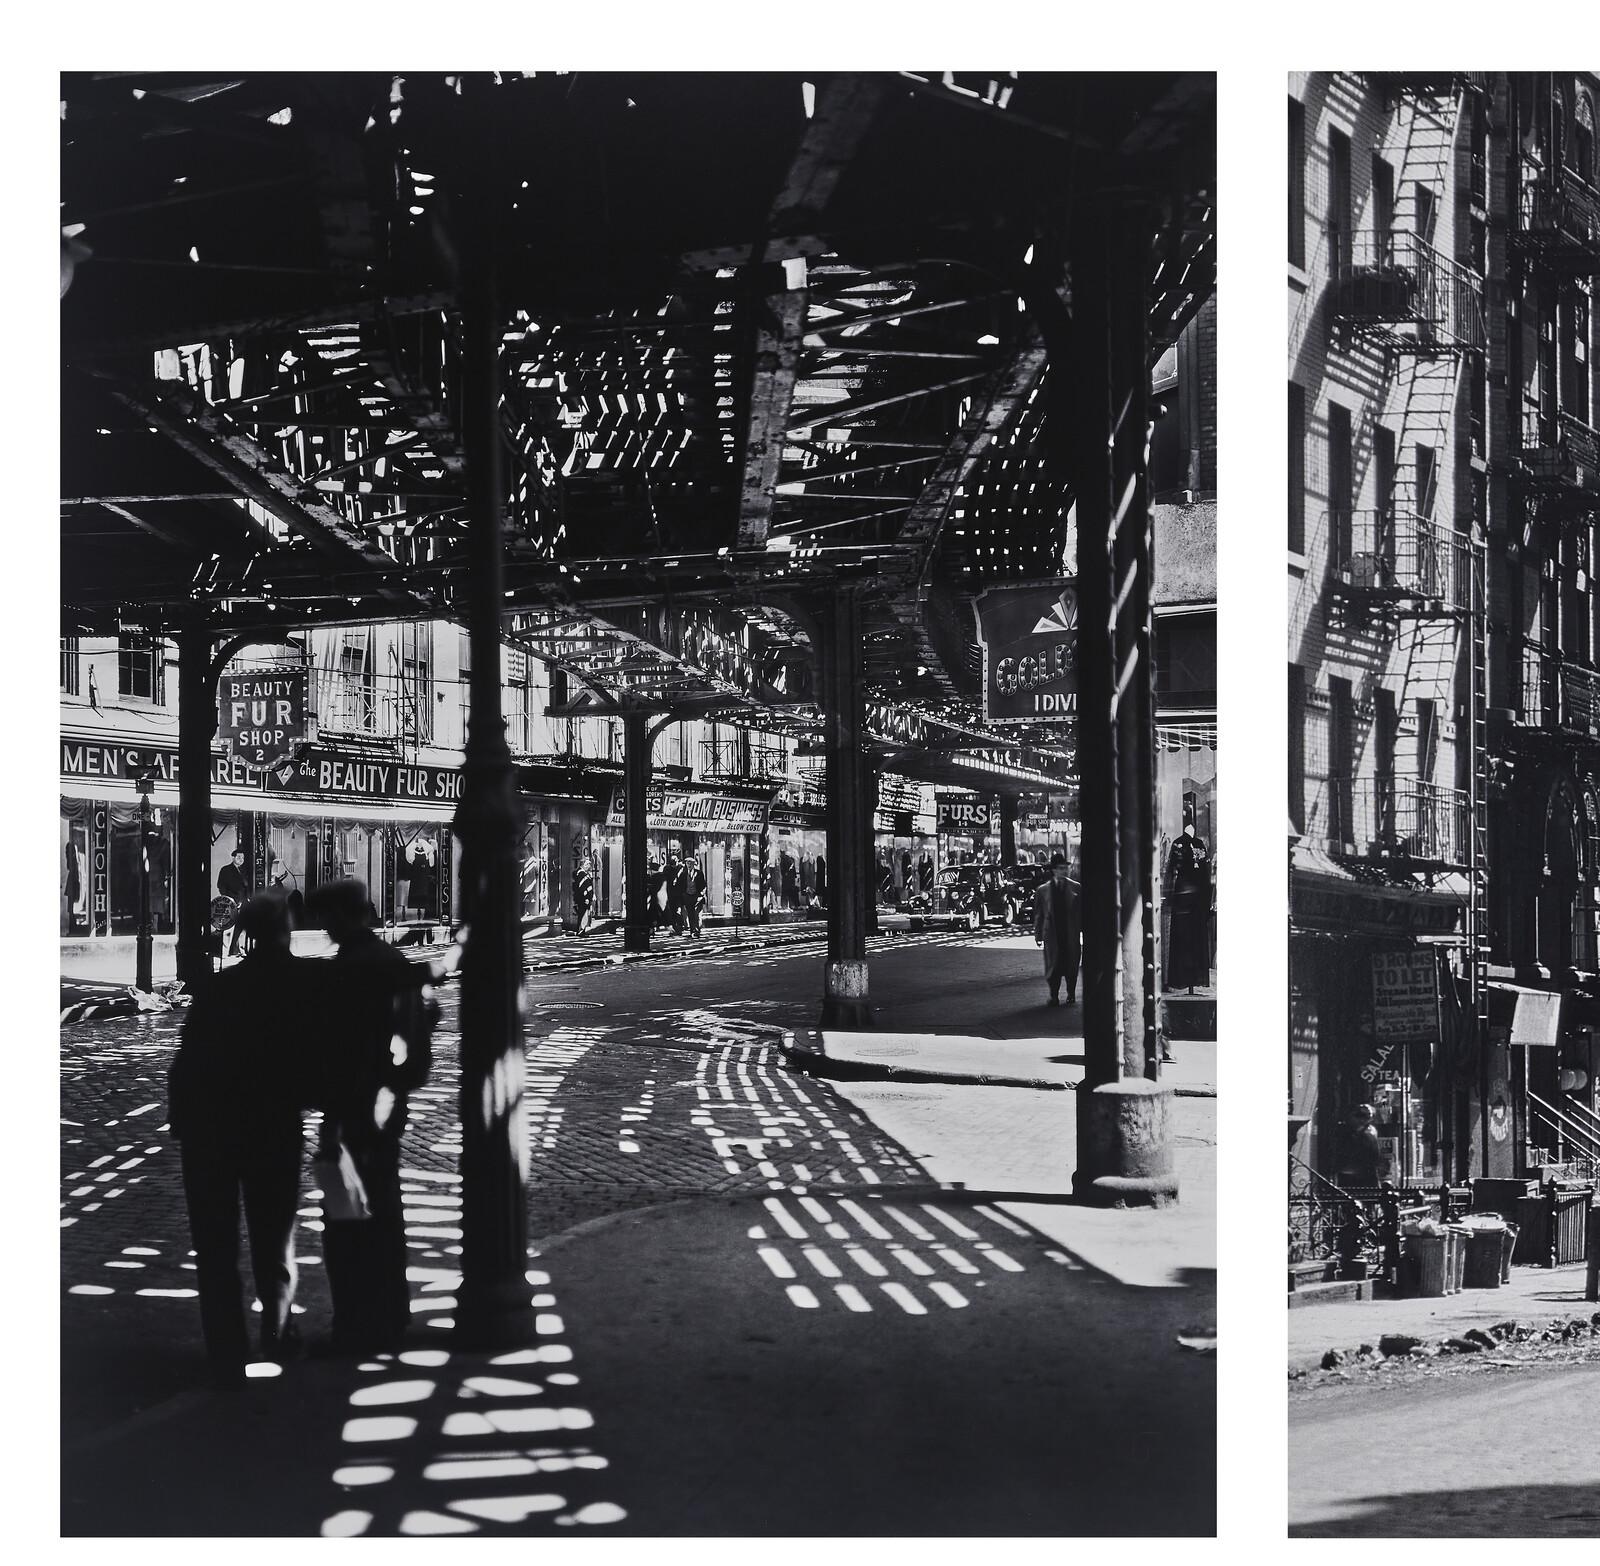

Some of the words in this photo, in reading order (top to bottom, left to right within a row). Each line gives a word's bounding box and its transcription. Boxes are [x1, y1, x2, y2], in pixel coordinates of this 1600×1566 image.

[231, 681, 294, 698] BEAUTY
[231, 699, 294, 728] FUR
[239, 730, 285, 746] SHOP
[65, 745, 139, 776] MEN'S
[256, 750, 264, 761] 2
[300, 760, 317, 777] The
[320, 760, 390, 793] BEAUTY
[397, 767, 429, 797] FUR
[677, 797, 711, 819] FROM
[937, 804, 988, 825] FURS
[668, 820, 685, 828] COATS
[686, 820, 700, 829] MUST
[95, 811, 107, 913] CLOTH
[442, 828, 450, 904] FURS
[1387, 952, 1433, 968] ROMS
[1401, 967, 1431, 984] LET
[1379, 1070, 1401, 1081] TEA
